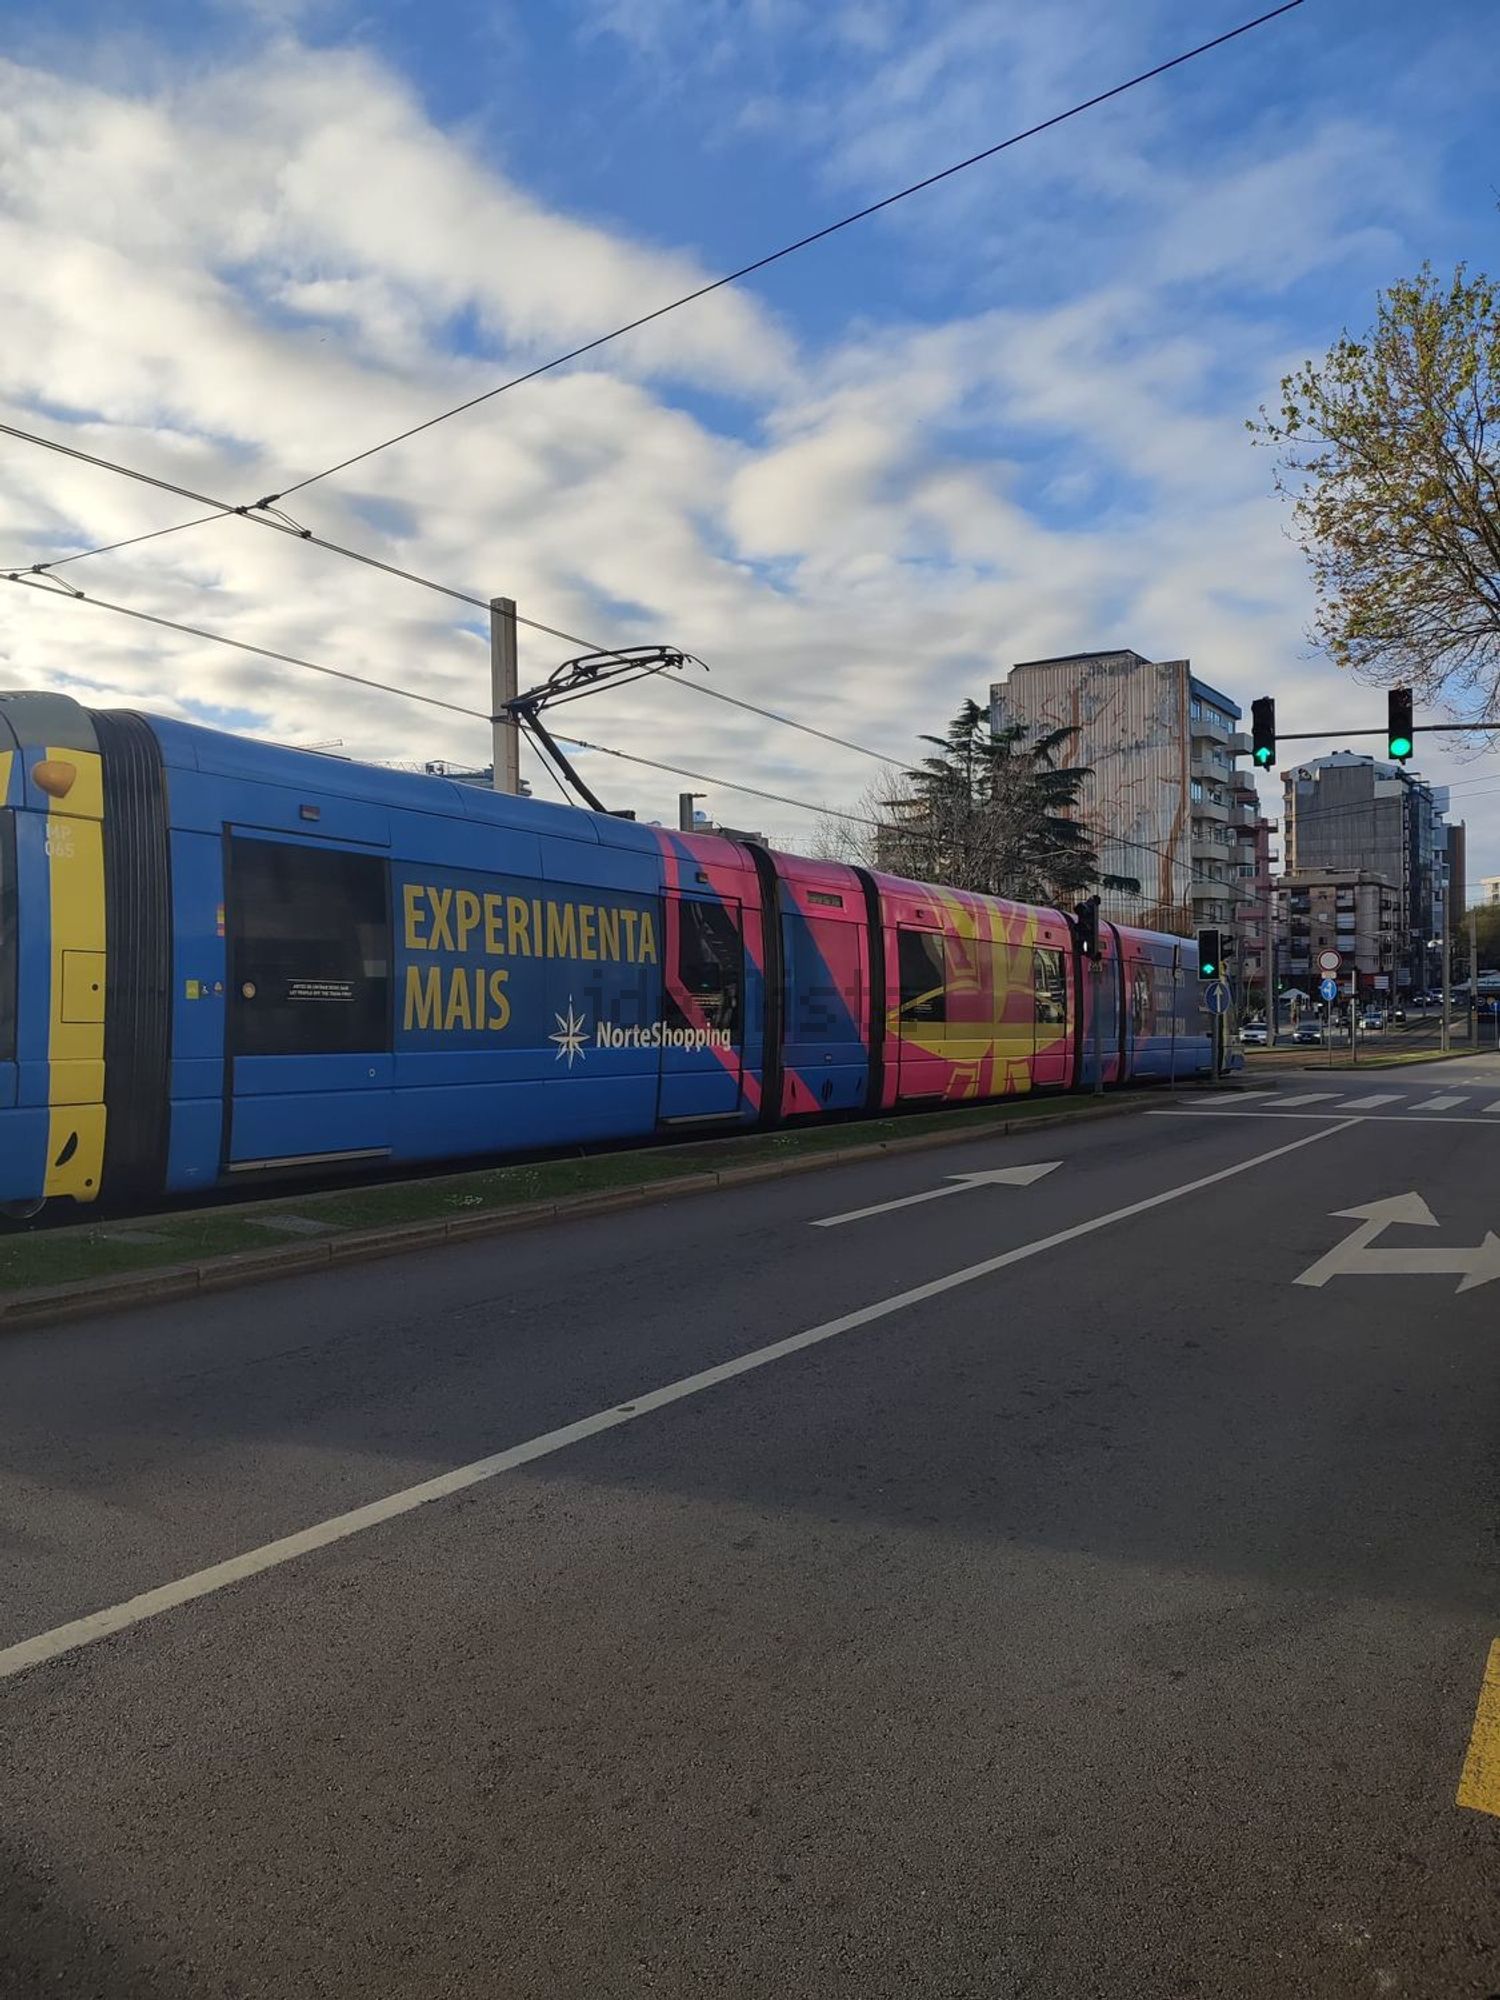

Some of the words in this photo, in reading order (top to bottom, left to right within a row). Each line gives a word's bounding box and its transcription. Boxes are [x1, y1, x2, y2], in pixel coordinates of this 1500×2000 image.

[403, 884, 658, 964] EXPERIMENTA
[403, 965, 512, 1031] MAIS
[596, 1021, 732, 1051] NorteShopping
